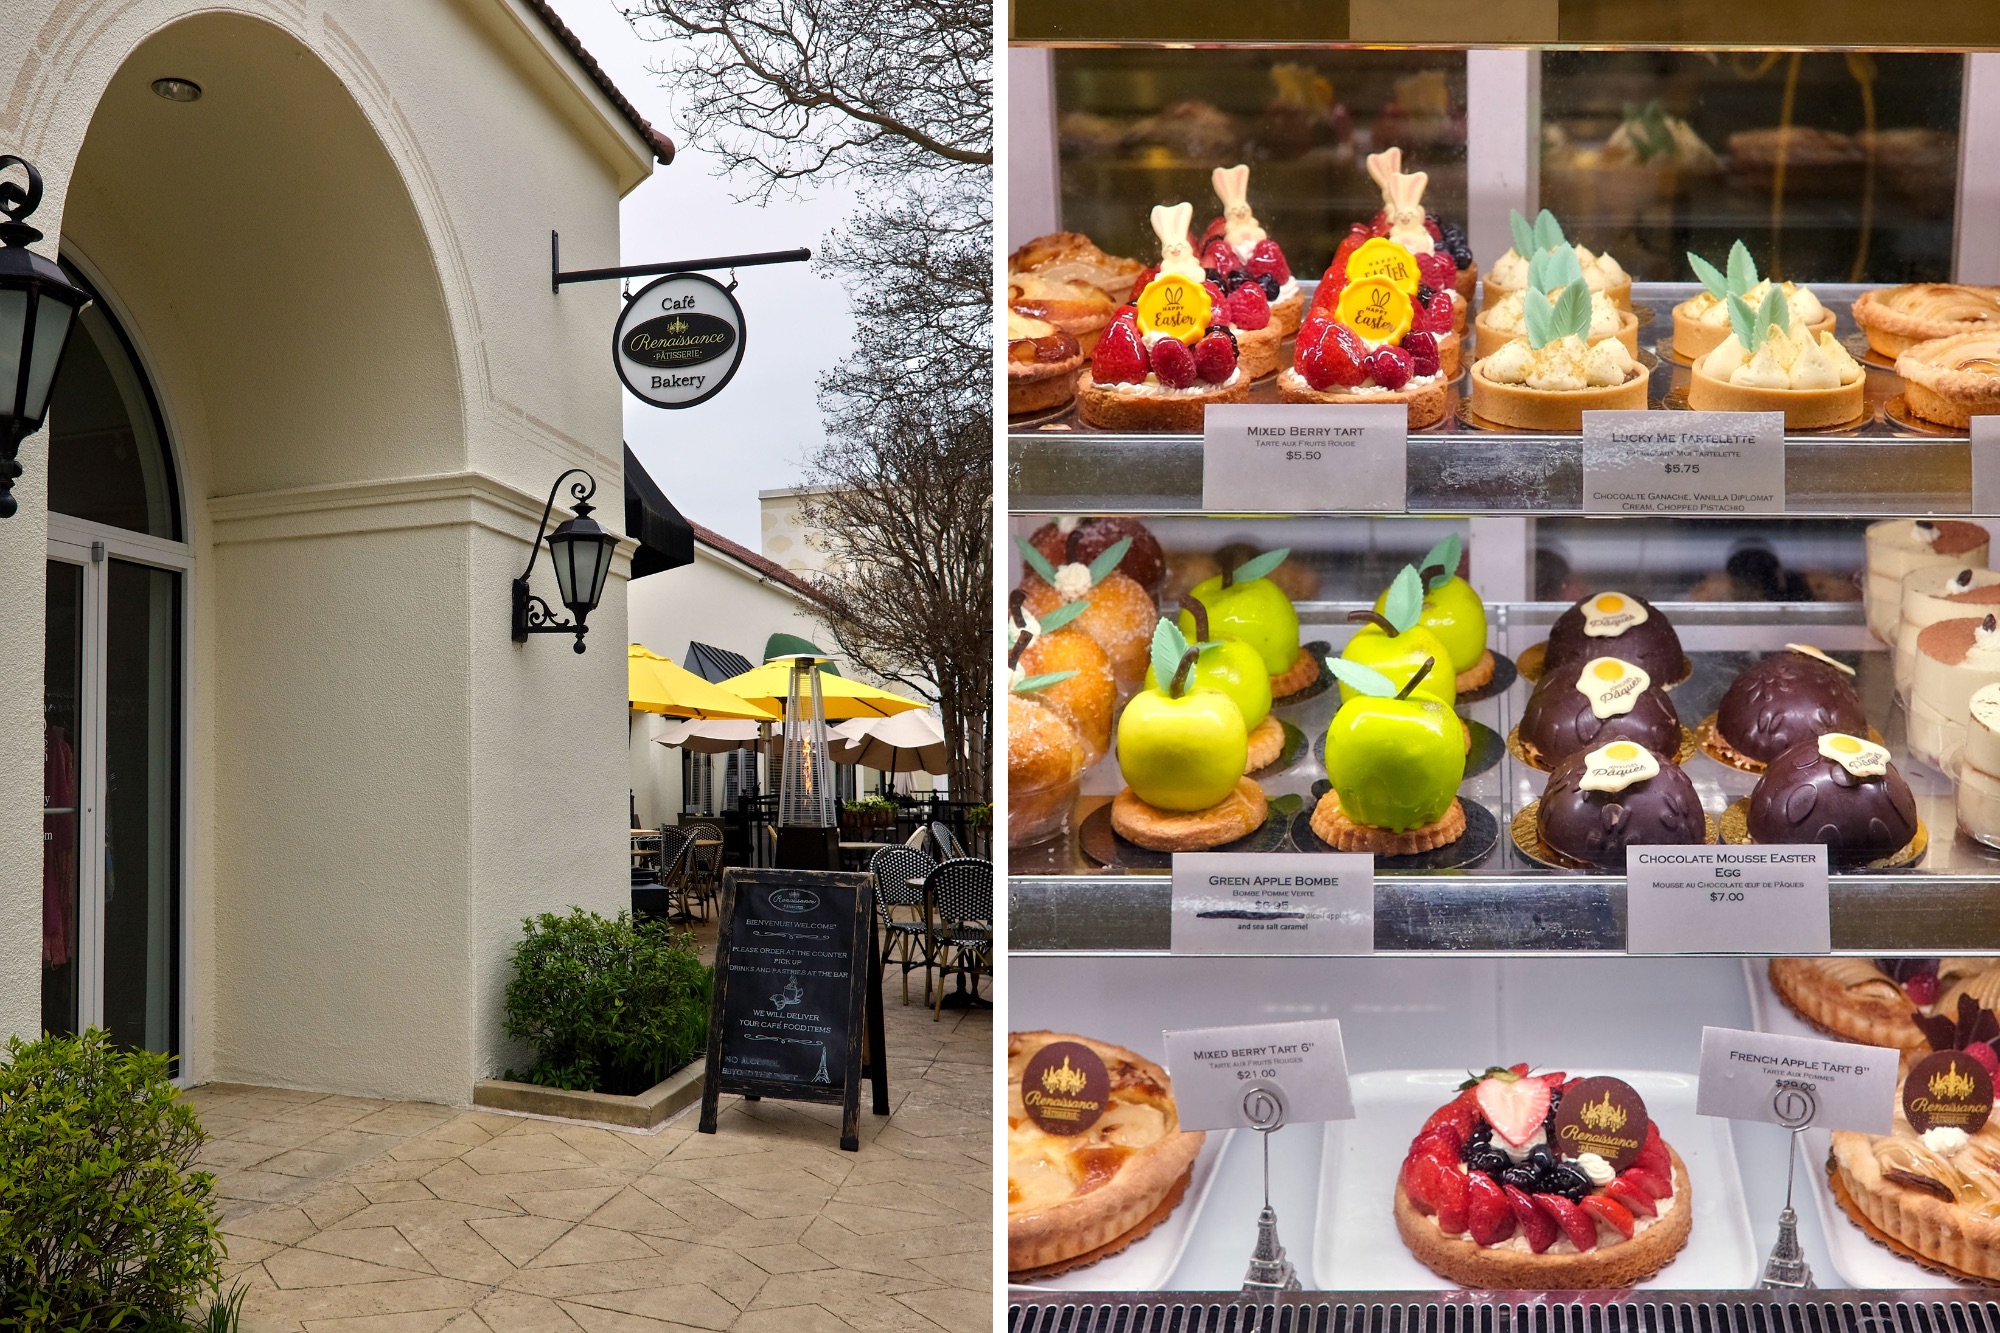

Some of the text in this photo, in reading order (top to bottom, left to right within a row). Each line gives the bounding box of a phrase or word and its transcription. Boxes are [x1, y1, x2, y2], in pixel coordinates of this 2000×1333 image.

[661, 295, 696, 311] Café
[1366, 306, 1388, 315] HAPPY
[1154, 311, 1196, 327] Easter
[1354, 310, 1395, 333] Easter
[630, 332, 726, 352] Renaissance
[651, 374, 706, 389] Bakery
[1247, 426, 1286, 436] MIXED
[1290, 426, 1331, 436] BERRY
[1612, 432, 1653, 443] LUCKY
[1657, 433, 1676, 443] ME
[1286, 450, 1322, 461] $5.50
[1664, 463, 1700, 474] $5.75
[1647, 492, 1692, 502] GANACHE,
[1693, 493, 1729, 501] VANILLA
[1730, 493, 1774, 502] DIPLOMAT
[1622, 503, 1745, 512] CREAM, CHOPPED PISTACHIO
[1592, 764, 1646, 778] Pâques
[1638, 854, 1816, 864] CHOCOLATE MOUSSE EASTER
[1715, 867, 1741, 878] EGG
[1208, 875, 1339, 886] GREEN APPLE BOMBE
[1652, 881, 1684, 889] MOUSSE
[1697, 881, 1743, 889] CHOCOLATE
[1710, 892, 1744, 902] $7.00
[1326, 912, 1350, 921] appl
[732, 946, 759, 954] PLEASE
[760, 947, 785, 955] ORDER
[811, 951, 848, 959] COUNTER
[818, 970, 833, 978] THE
[753, 1009, 820, 1022] WE WILL DELIVER
[739, 1019, 832, 1034] YOUR CAFÉ FOOD ITEMS
[1193, 1050, 1228, 1061] MIXED
[1231, 1048, 1267, 1058] BERRY
[1268, 1045, 1297, 1055] TART
[1209, 1062, 1231, 1070] TARTE
[1247, 1059, 1272, 1067] FRUITS
[1273, 1057, 1303, 1065] ROUGES
[1729, 1051, 1778, 1065] FRENCH
[1780, 1057, 1819, 1070] APPLE
[1821, 1061, 1852, 1074] TART
[1237, 1069, 1276, 1080] $21.00
[1762, 1067, 1785, 1076] TARTE
[1803, 1072, 1835, 1082] POMMES
[1775, 1079, 1816, 1091] $2900
[1024, 1090, 1099, 1111] Renaissance
[1910, 1097, 1988, 1113] Renaissance
[1561, 1124, 1639, 1149] Renaissance
